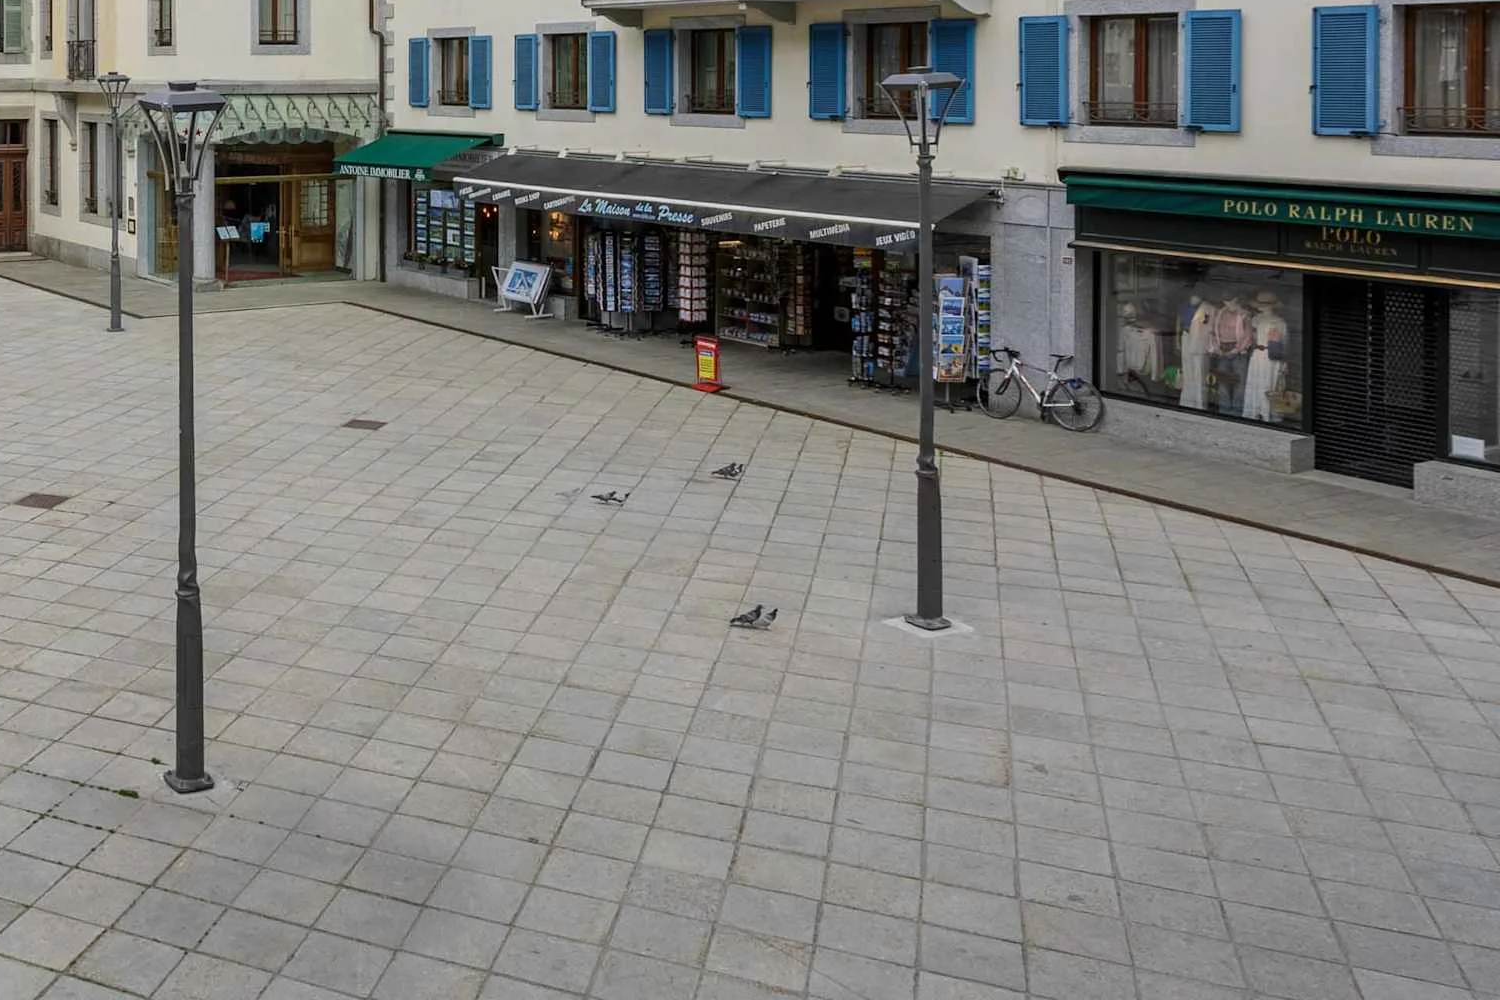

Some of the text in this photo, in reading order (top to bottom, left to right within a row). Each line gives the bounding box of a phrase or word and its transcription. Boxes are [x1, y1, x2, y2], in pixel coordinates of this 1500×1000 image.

[340, 164, 369, 176] ANTOINE
[370, 166, 411, 179] IMMOBILIER
[578, 199, 592, 213] La
[595, 199, 631, 216] Maison
[644, 203, 653, 213] la
[657, 205, 694, 224] Presse
[700, 212, 733, 226] SOUVENIRS
[1223, 199, 1475, 232] POLO RALPH LAUREN
[753, 217, 786, 232] PAPETERIE
[809, 223, 851, 240] MULTIMÉDIA
[875, 230, 916, 247] JEUX VIDÉO
[1321, 226, 1381, 245] POLO
